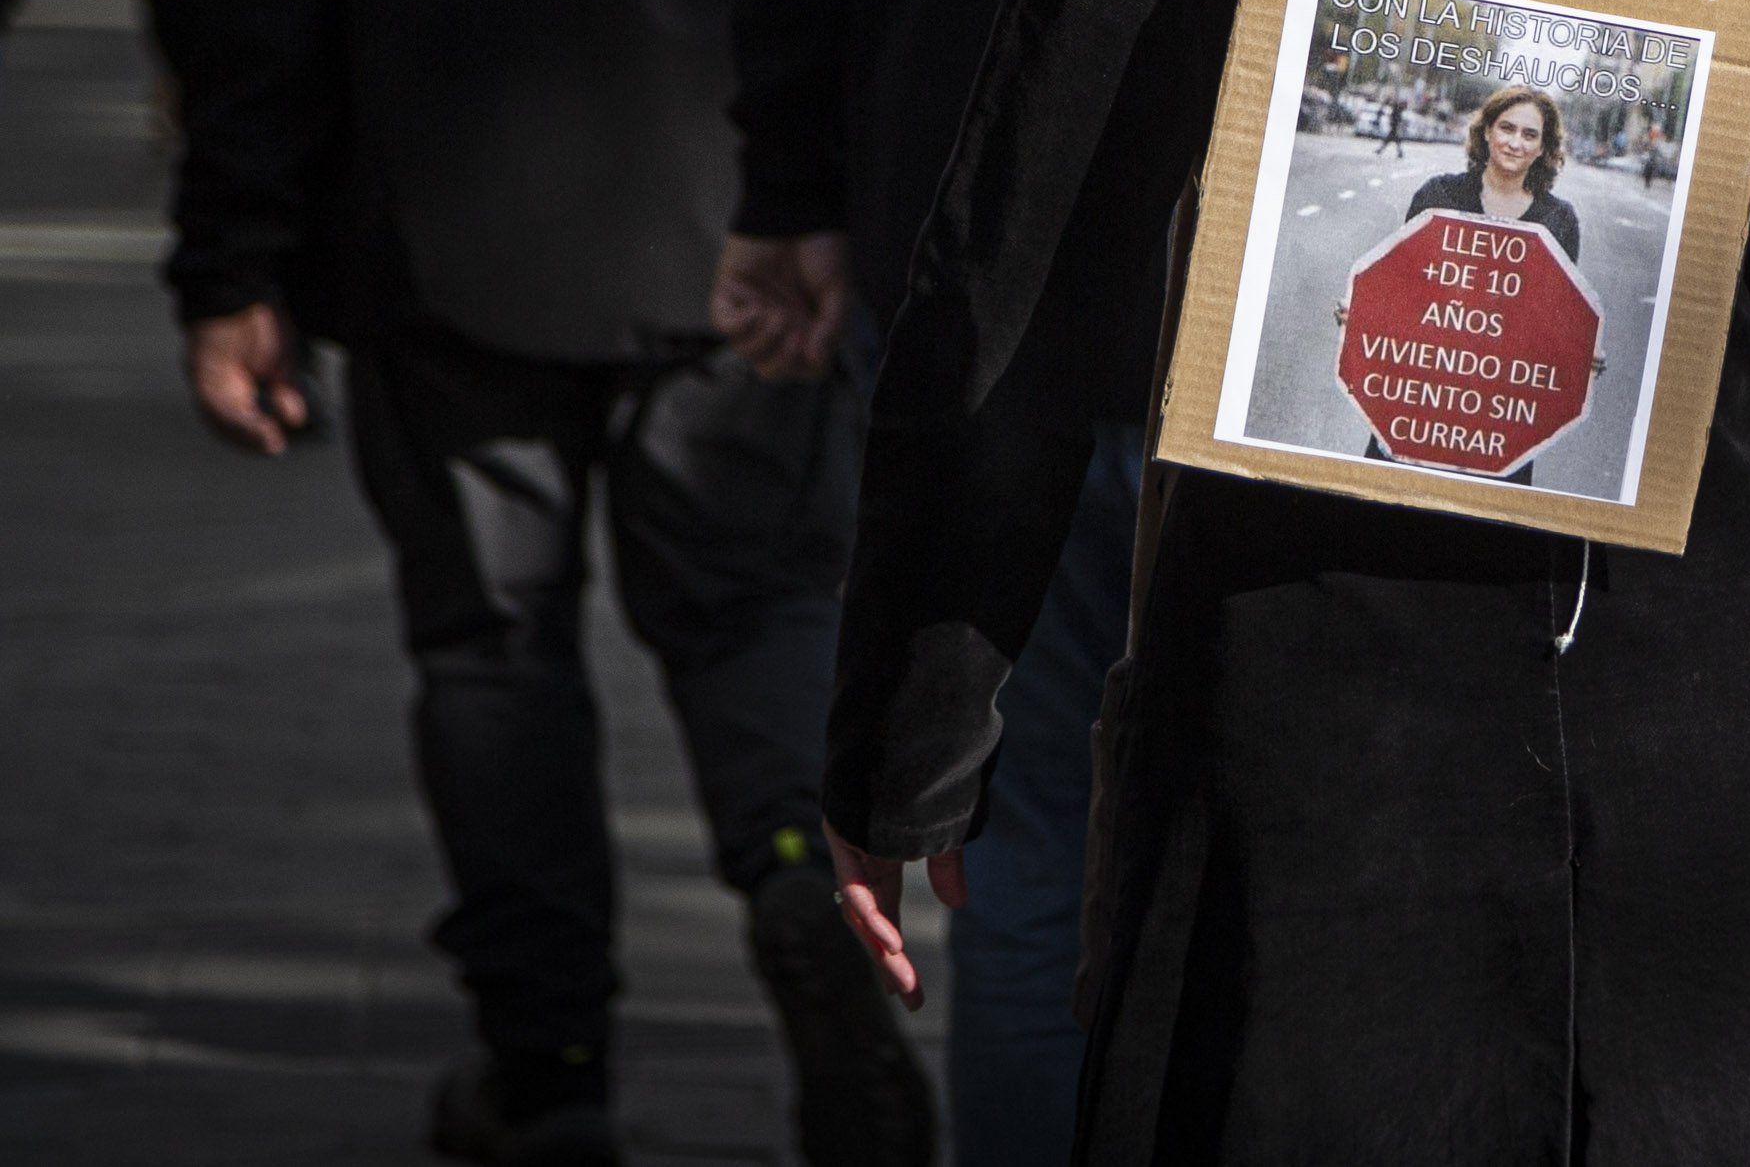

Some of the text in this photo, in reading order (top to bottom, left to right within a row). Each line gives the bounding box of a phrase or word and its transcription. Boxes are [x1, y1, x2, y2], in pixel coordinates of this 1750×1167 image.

[1330, 23, 1401, 60] LOS
[1470, 5, 1633, 60] HISTORIA
[1641, 36, 1691, 70] DE
[1441, 225, 1527, 264] LLEVO
[1423, 261, 1522, 297] +DE 10
[1420, 300, 1503, 337] AÑOS
[1361, 333, 1562, 391] VIVIENDO DEL
[1363, 372, 1537, 424] CUENTO SIN
[1390, 416, 1506, 457] CURRAR
